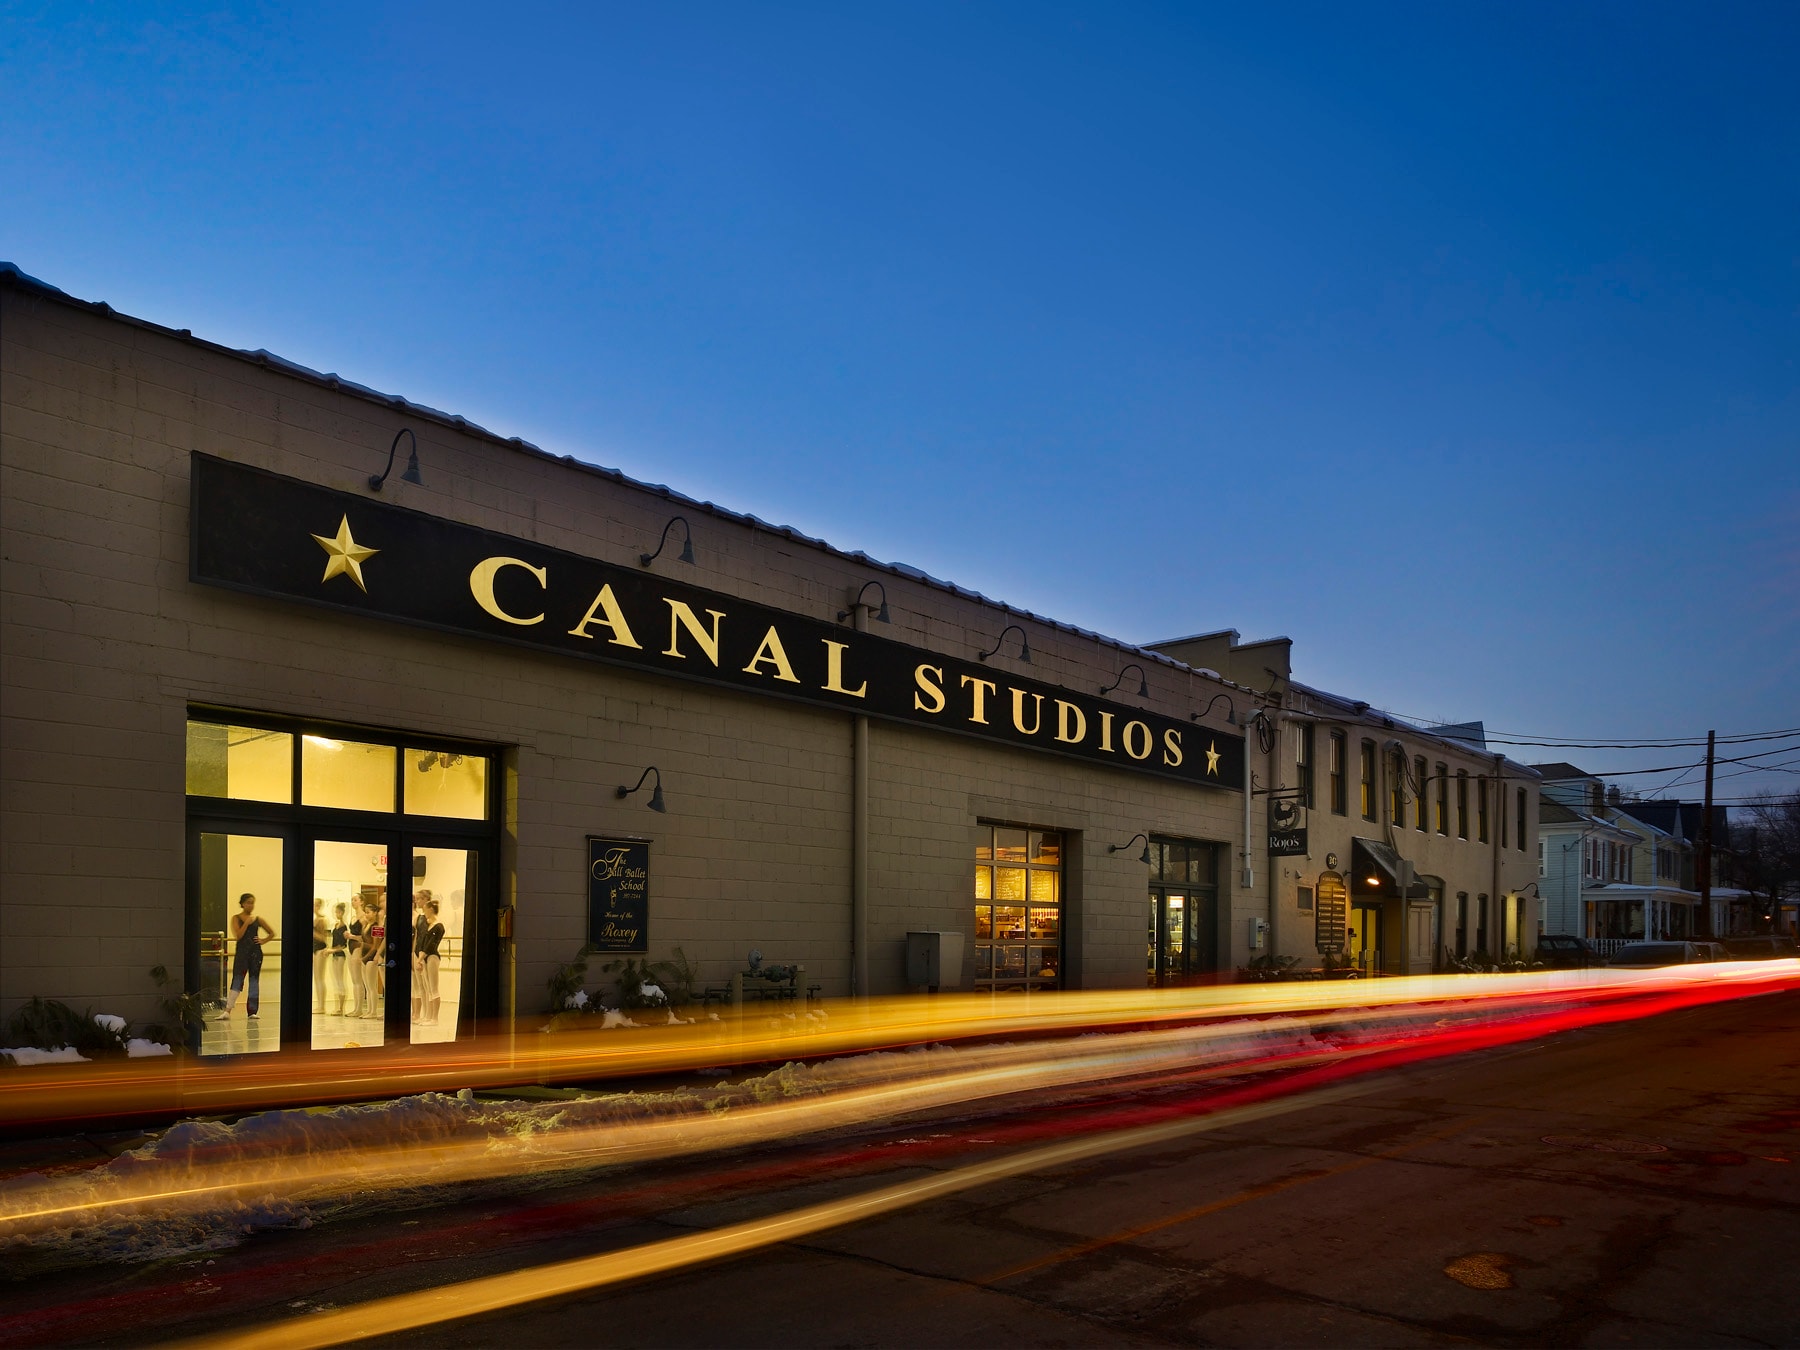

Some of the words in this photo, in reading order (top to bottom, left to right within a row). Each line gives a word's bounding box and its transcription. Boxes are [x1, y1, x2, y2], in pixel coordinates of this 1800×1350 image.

[469, 556, 867, 698] CANAL
[914, 664, 1183, 767] STUDIOS
[1269, 835, 1300, 851] Rojo's
[592, 847, 631, 881] The
[625, 868, 645, 878] Ballet
[619, 880, 645, 890] School
[619, 912, 625, 920] of
[625, 911, 633, 919] the
[601, 922, 638, 943] Roxey
